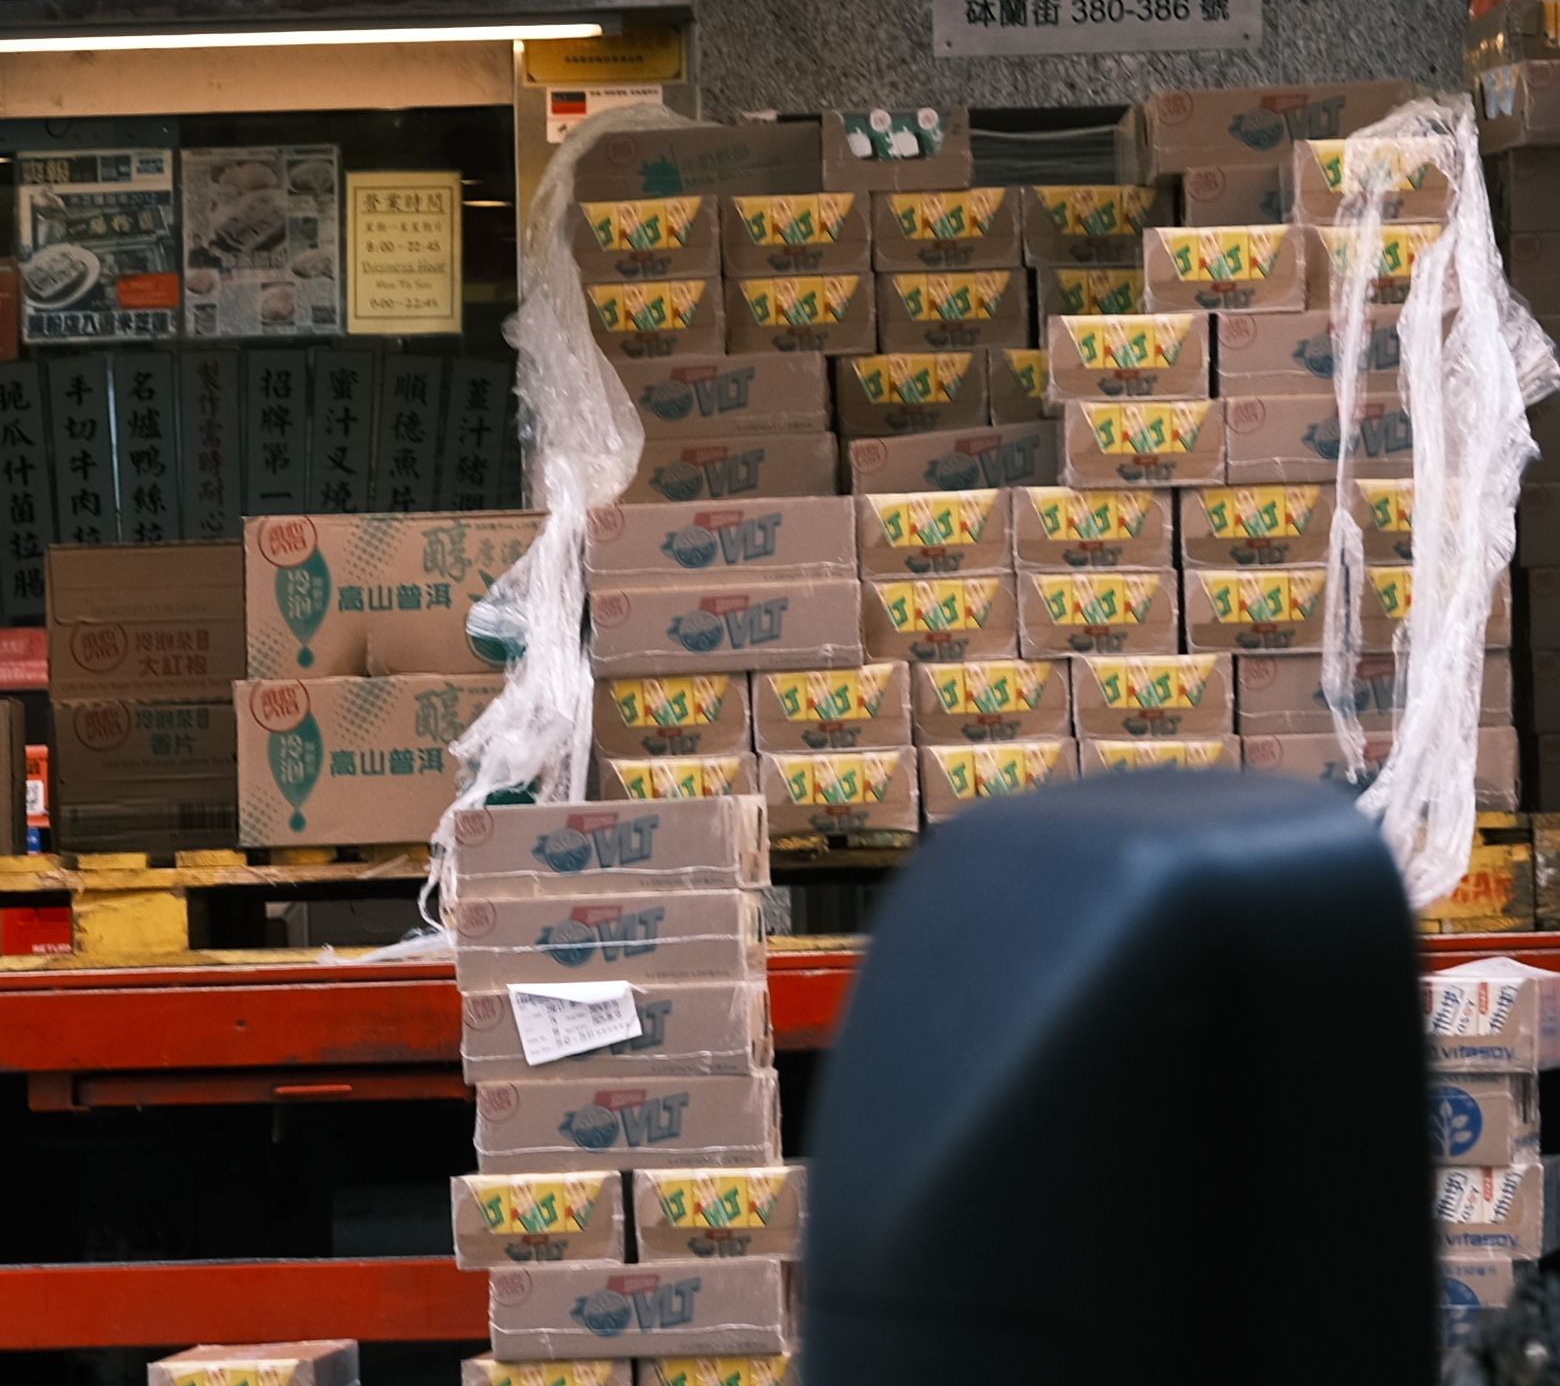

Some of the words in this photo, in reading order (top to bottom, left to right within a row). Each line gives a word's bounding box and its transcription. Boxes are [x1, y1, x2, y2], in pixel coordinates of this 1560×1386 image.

[692, 366, 756, 418] VLT
[258, 367, 294, 500] 招牌第一
[320, 366, 360, 513] 蜜汁叉燒
[979, 433, 1041, 485] VLT
[702, 448, 765, 498] VLT
[717, 512, 783, 565] VLT
[338, 582, 453, 612] 高山普洱
[723, 596, 789, 650] VLT
[330, 747, 445, 777] 高山普洱
[593, 814, 660, 869] VLT
[597, 906, 666, 964] VLT
[619, 1090, 689, 1148] VLT
[1445, 1233, 1519, 1250] vitasoy
[633, 1276, 702, 1333] VLT
